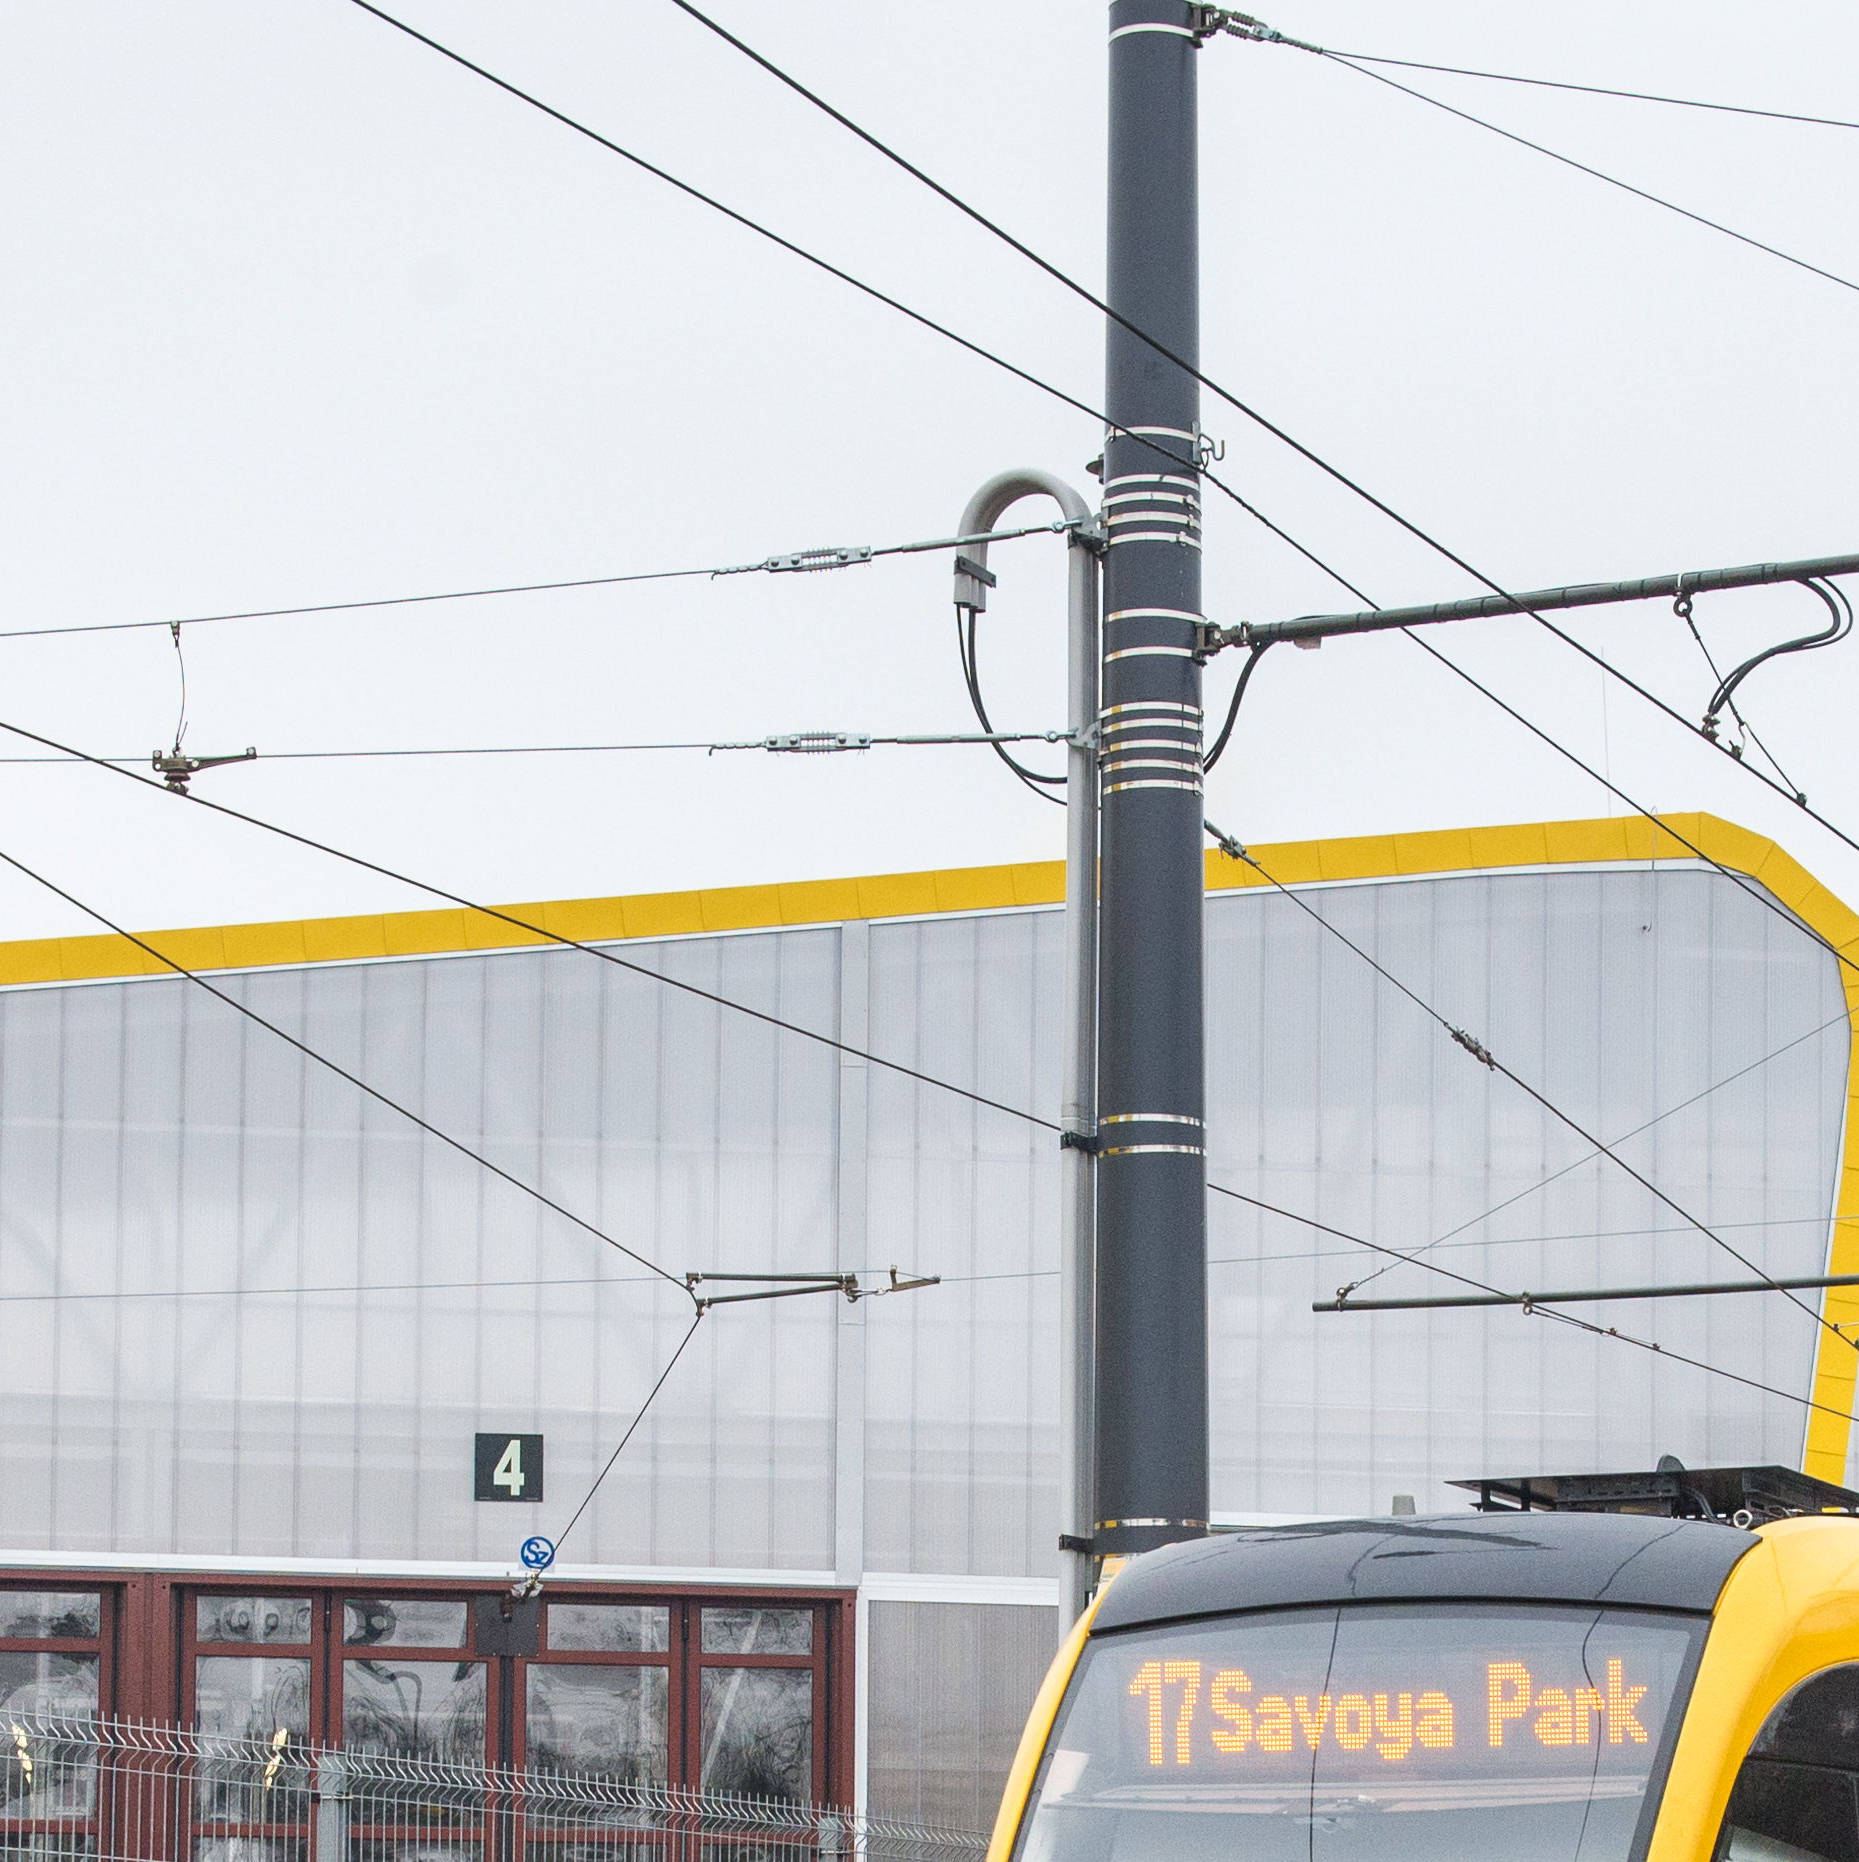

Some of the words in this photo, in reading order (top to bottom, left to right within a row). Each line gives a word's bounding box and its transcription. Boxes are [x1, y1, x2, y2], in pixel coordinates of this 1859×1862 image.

[493, 1439, 525, 1496] 4
[1129, 1661, 1201, 1765] 17
[1211, 1669, 1454, 1760] Savoya
[1487, 1659, 1648, 1747] Park
